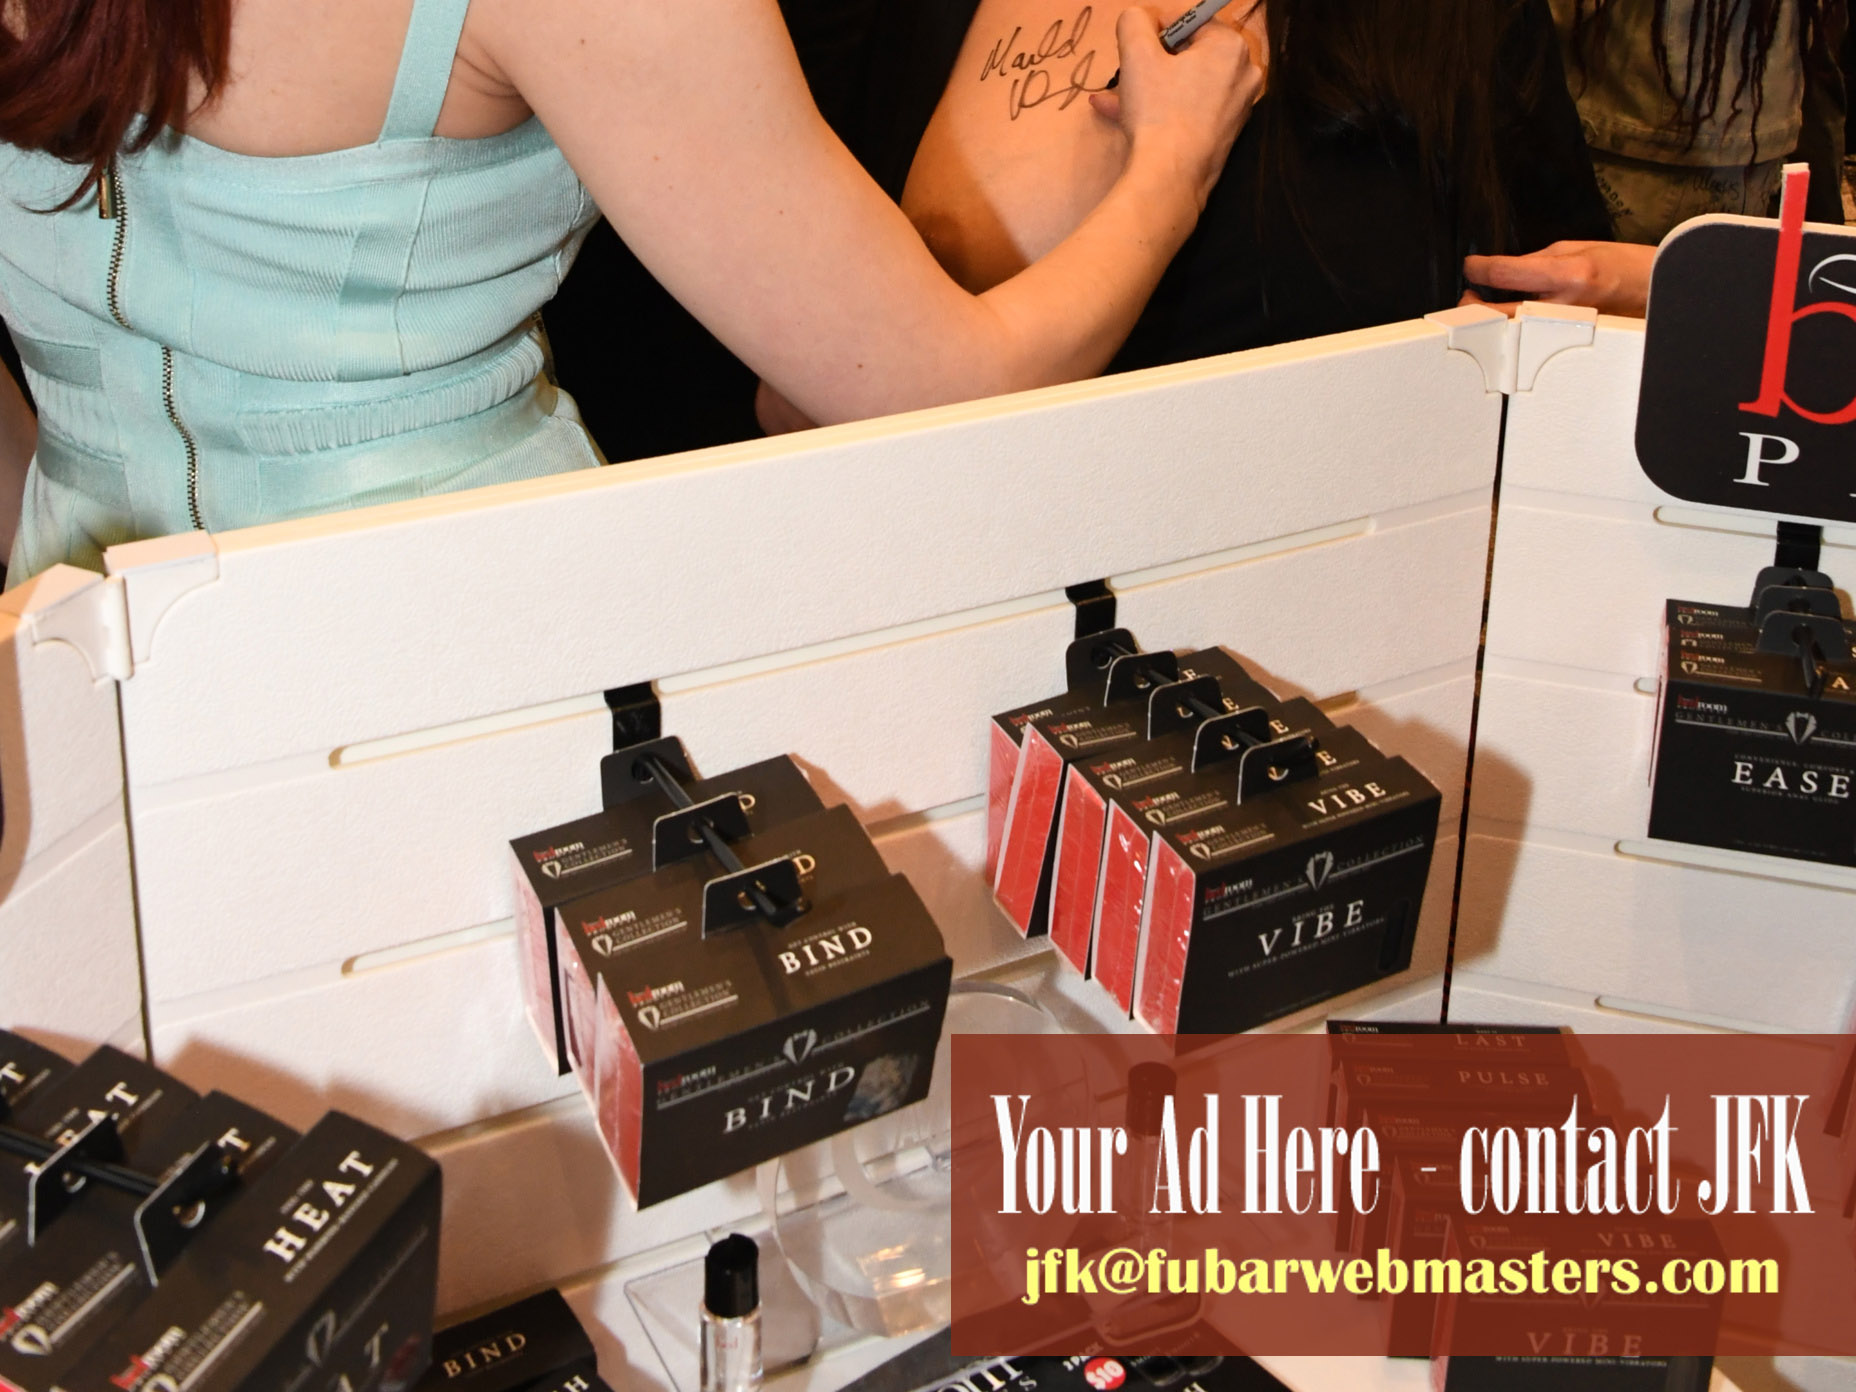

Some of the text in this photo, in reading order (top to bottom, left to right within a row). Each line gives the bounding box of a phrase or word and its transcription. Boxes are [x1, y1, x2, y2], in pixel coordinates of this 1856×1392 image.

[1731, 761, 1851, 799] EASE
[1307, 782, 1387, 815] VIBE
[1258, 899, 1364, 956] VIBE
[777, 926, 873, 975] BIND
[1455, 1033, 1526, 1047] LAST
[1459, 1071, 1549, 1086] PULSE
[723, 1065, 855, 1134] BIND
[263, 1150, 374, 1264] HEAT
[1597, 1232, 1677, 1249] VIBE
[442, 1332, 527, 1379] BIND
[1527, 1332, 1643, 1358] VIBE
[1085, 1360, 1125, 1391] $10
